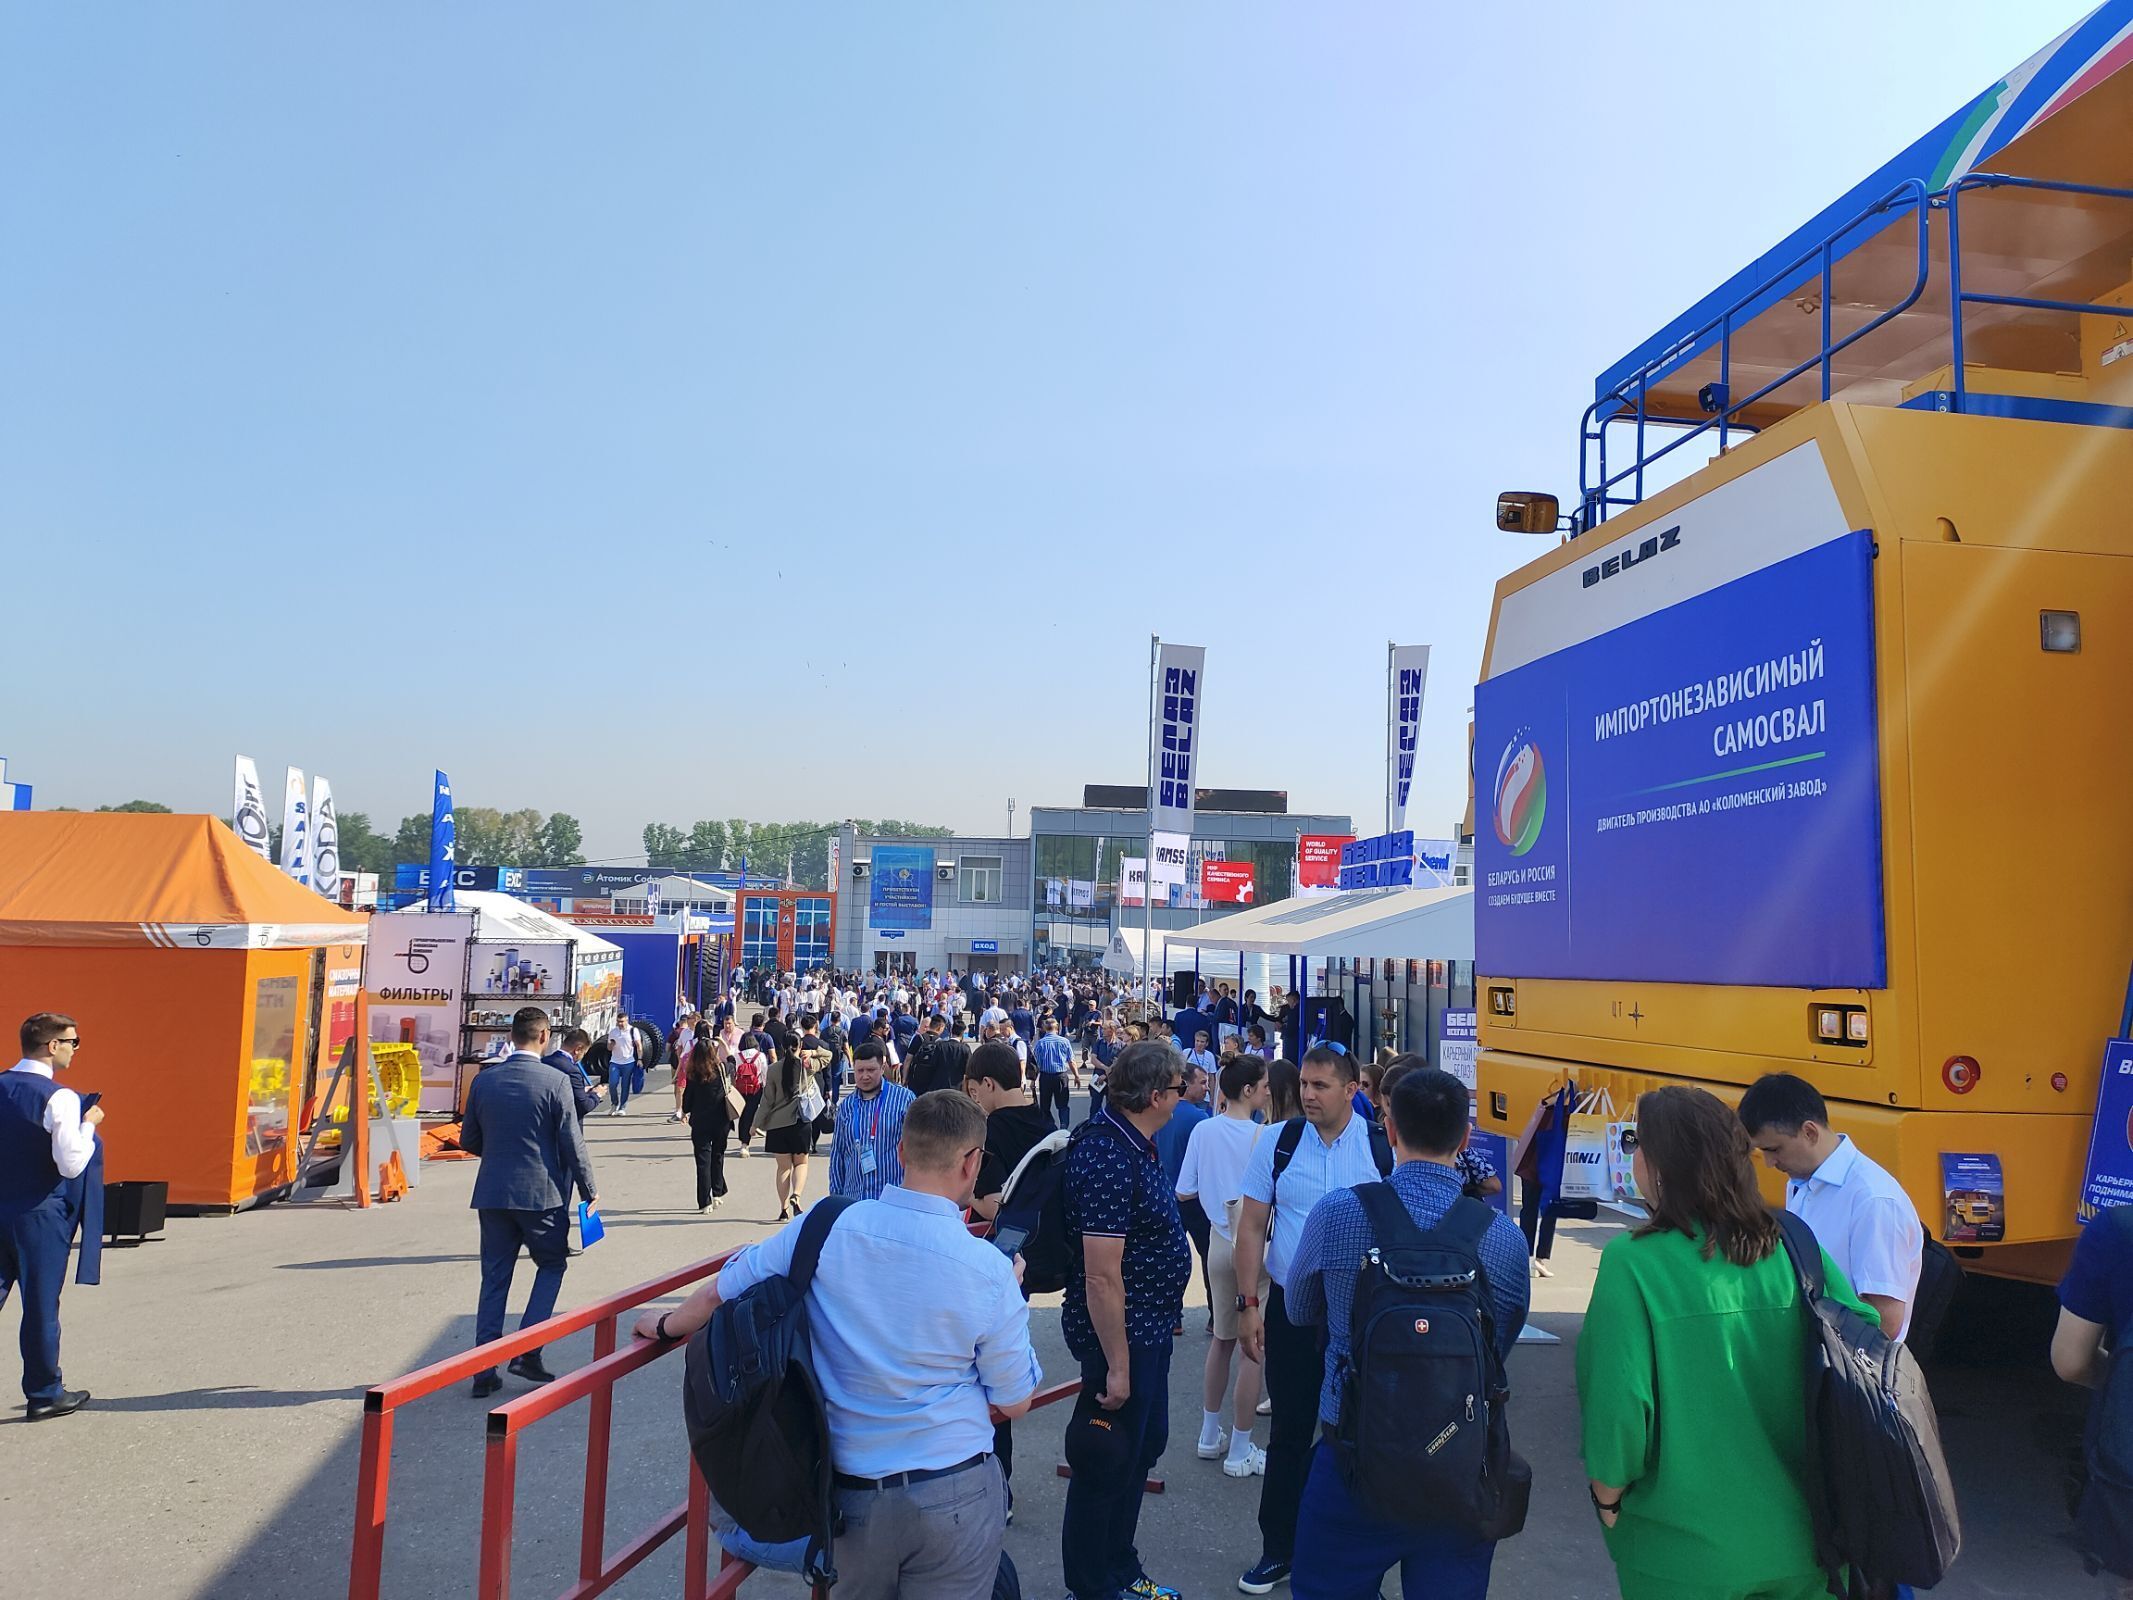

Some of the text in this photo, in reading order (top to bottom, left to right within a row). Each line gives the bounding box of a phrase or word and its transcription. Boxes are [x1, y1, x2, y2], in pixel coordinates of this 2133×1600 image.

[1582, 525, 1681, 589] BELAZ
[1594, 638, 1825, 742] ИМПОРТОНЕЗАВИСИМЫЙ
[1713, 699, 1826, 757] САМОСВАЛ
[1597, 778, 1828, 834] ДВИГАТЕЛЬ ПРОИЗВОДСТВА АО «КОЛОМЕНСКИЙ ЗАВОД»
[505, 871, 522, 888] EXC
[596, 873, 632, 883] Атомик
[1340, 859, 1414, 891] BELAZ
[1488, 864, 1556, 887] БЕЛАРУСЬ И РОССИЯ
[1488, 889, 1556, 907] СОЗДАЕМ БУДУЩЕЕ ВМЕСТЕ
[974, 942, 995, 950] ВХОД
[328, 968, 360, 981] СМАЗОЧНЫ
[379, 986, 454, 1002] ФИЛЬТРЫ
[1447, 1013, 1476, 1027] БЕЛ
[1442, 1043, 1473, 1060] КАРЬЕРНЫЙ
[1453, 1063, 1476, 1079] БЕЛАЗ-7
[2095, 1174, 2133, 1188] КАРЬЕРН
[2088, 1184, 2133, 1200] ПОДНИМА
[2092, 1196, 2099, 1204] В
[1428, 1423, 1457, 1454] GOODYEAR
